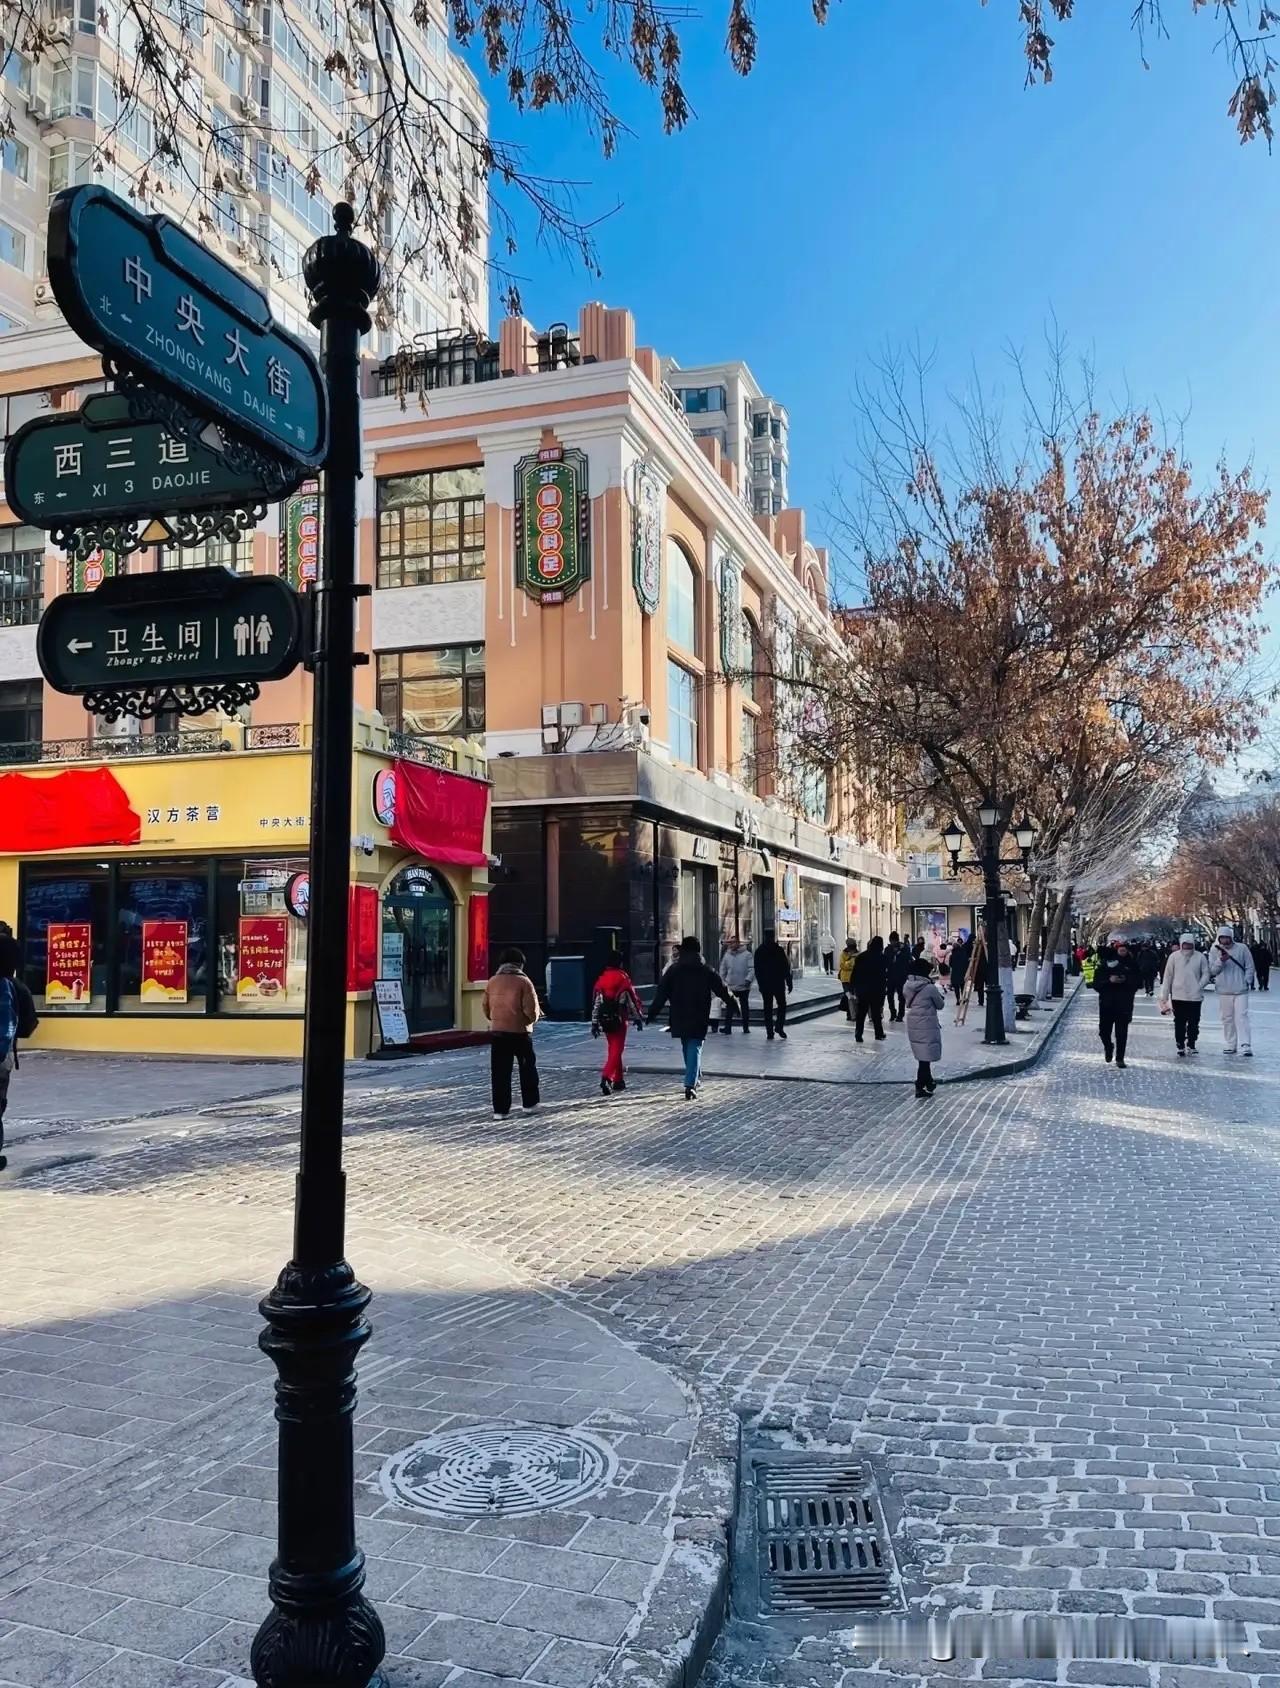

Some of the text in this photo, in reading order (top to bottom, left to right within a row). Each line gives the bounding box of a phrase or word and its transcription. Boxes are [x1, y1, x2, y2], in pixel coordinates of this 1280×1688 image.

[100, 295, 113, 315] 北
[125, 255, 292, 405] 中央大街
[145, 324, 277, 424] ZHONGYANG DAJIE
[92, 470, 211, 498] XI 3 DAOJIE
[33, 491, 45, 505] 东
[106, 620, 201, 654] 卫生间
[147, 805, 220, 824] 汉方茶营
[259, 816, 311, 828] 中央大街
